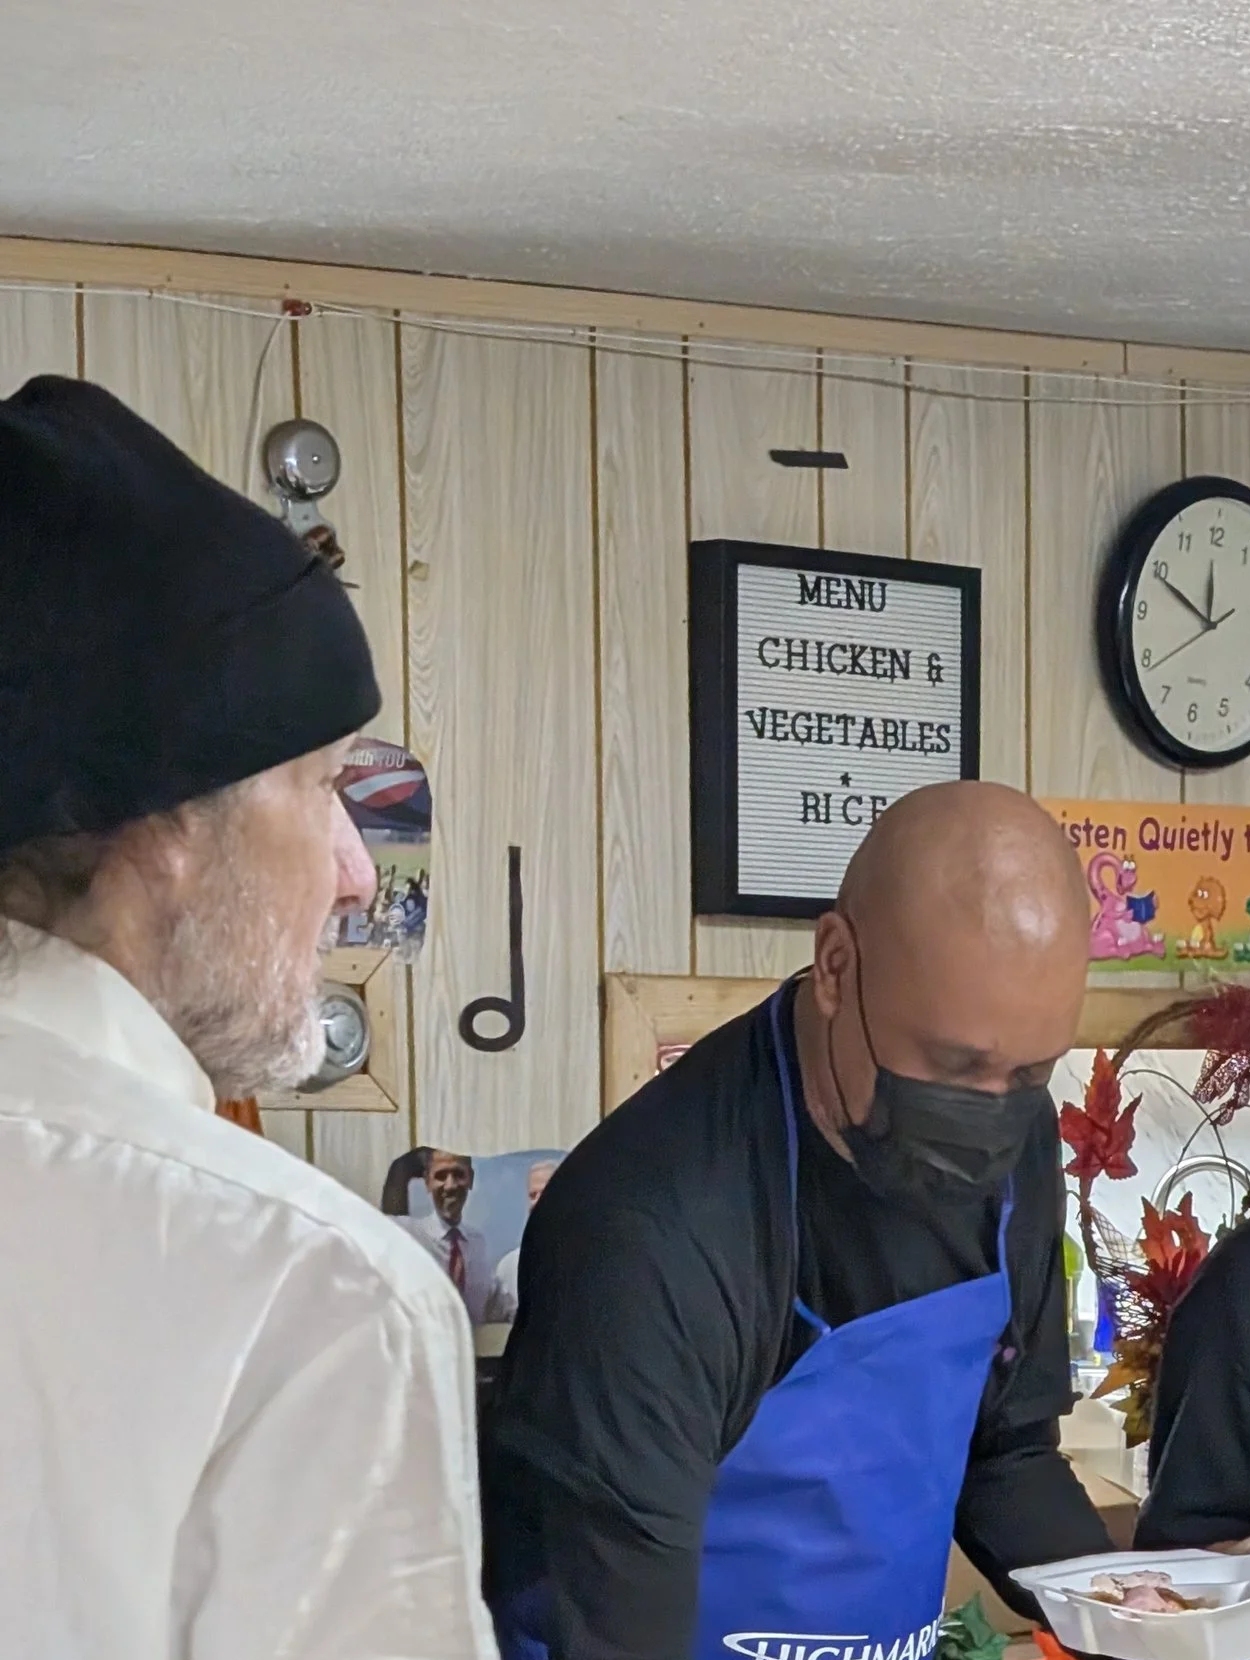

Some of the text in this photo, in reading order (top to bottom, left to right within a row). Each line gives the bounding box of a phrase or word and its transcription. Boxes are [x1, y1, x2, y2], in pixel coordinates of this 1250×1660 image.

[1177, 532, 1192, 553] 11
[1209, 526, 1224, 547] 12
[1241, 547, 1249, 565] 1
[1153, 560, 1168, 580] 10
[797, 573, 888, 612] MENU
[1137, 601, 1148, 620] 9
[756, 636, 945, 687] CHICKEN &
[1141, 648, 1152, 668] 8
[1161, 685, 1171, 704] 7
[1187, 703, 1198, 723] 6
[1218, 698, 1230, 717] 5
[745, 706, 952, 756] VEGETABLES
[1138, 815, 1235, 862] Quietly
